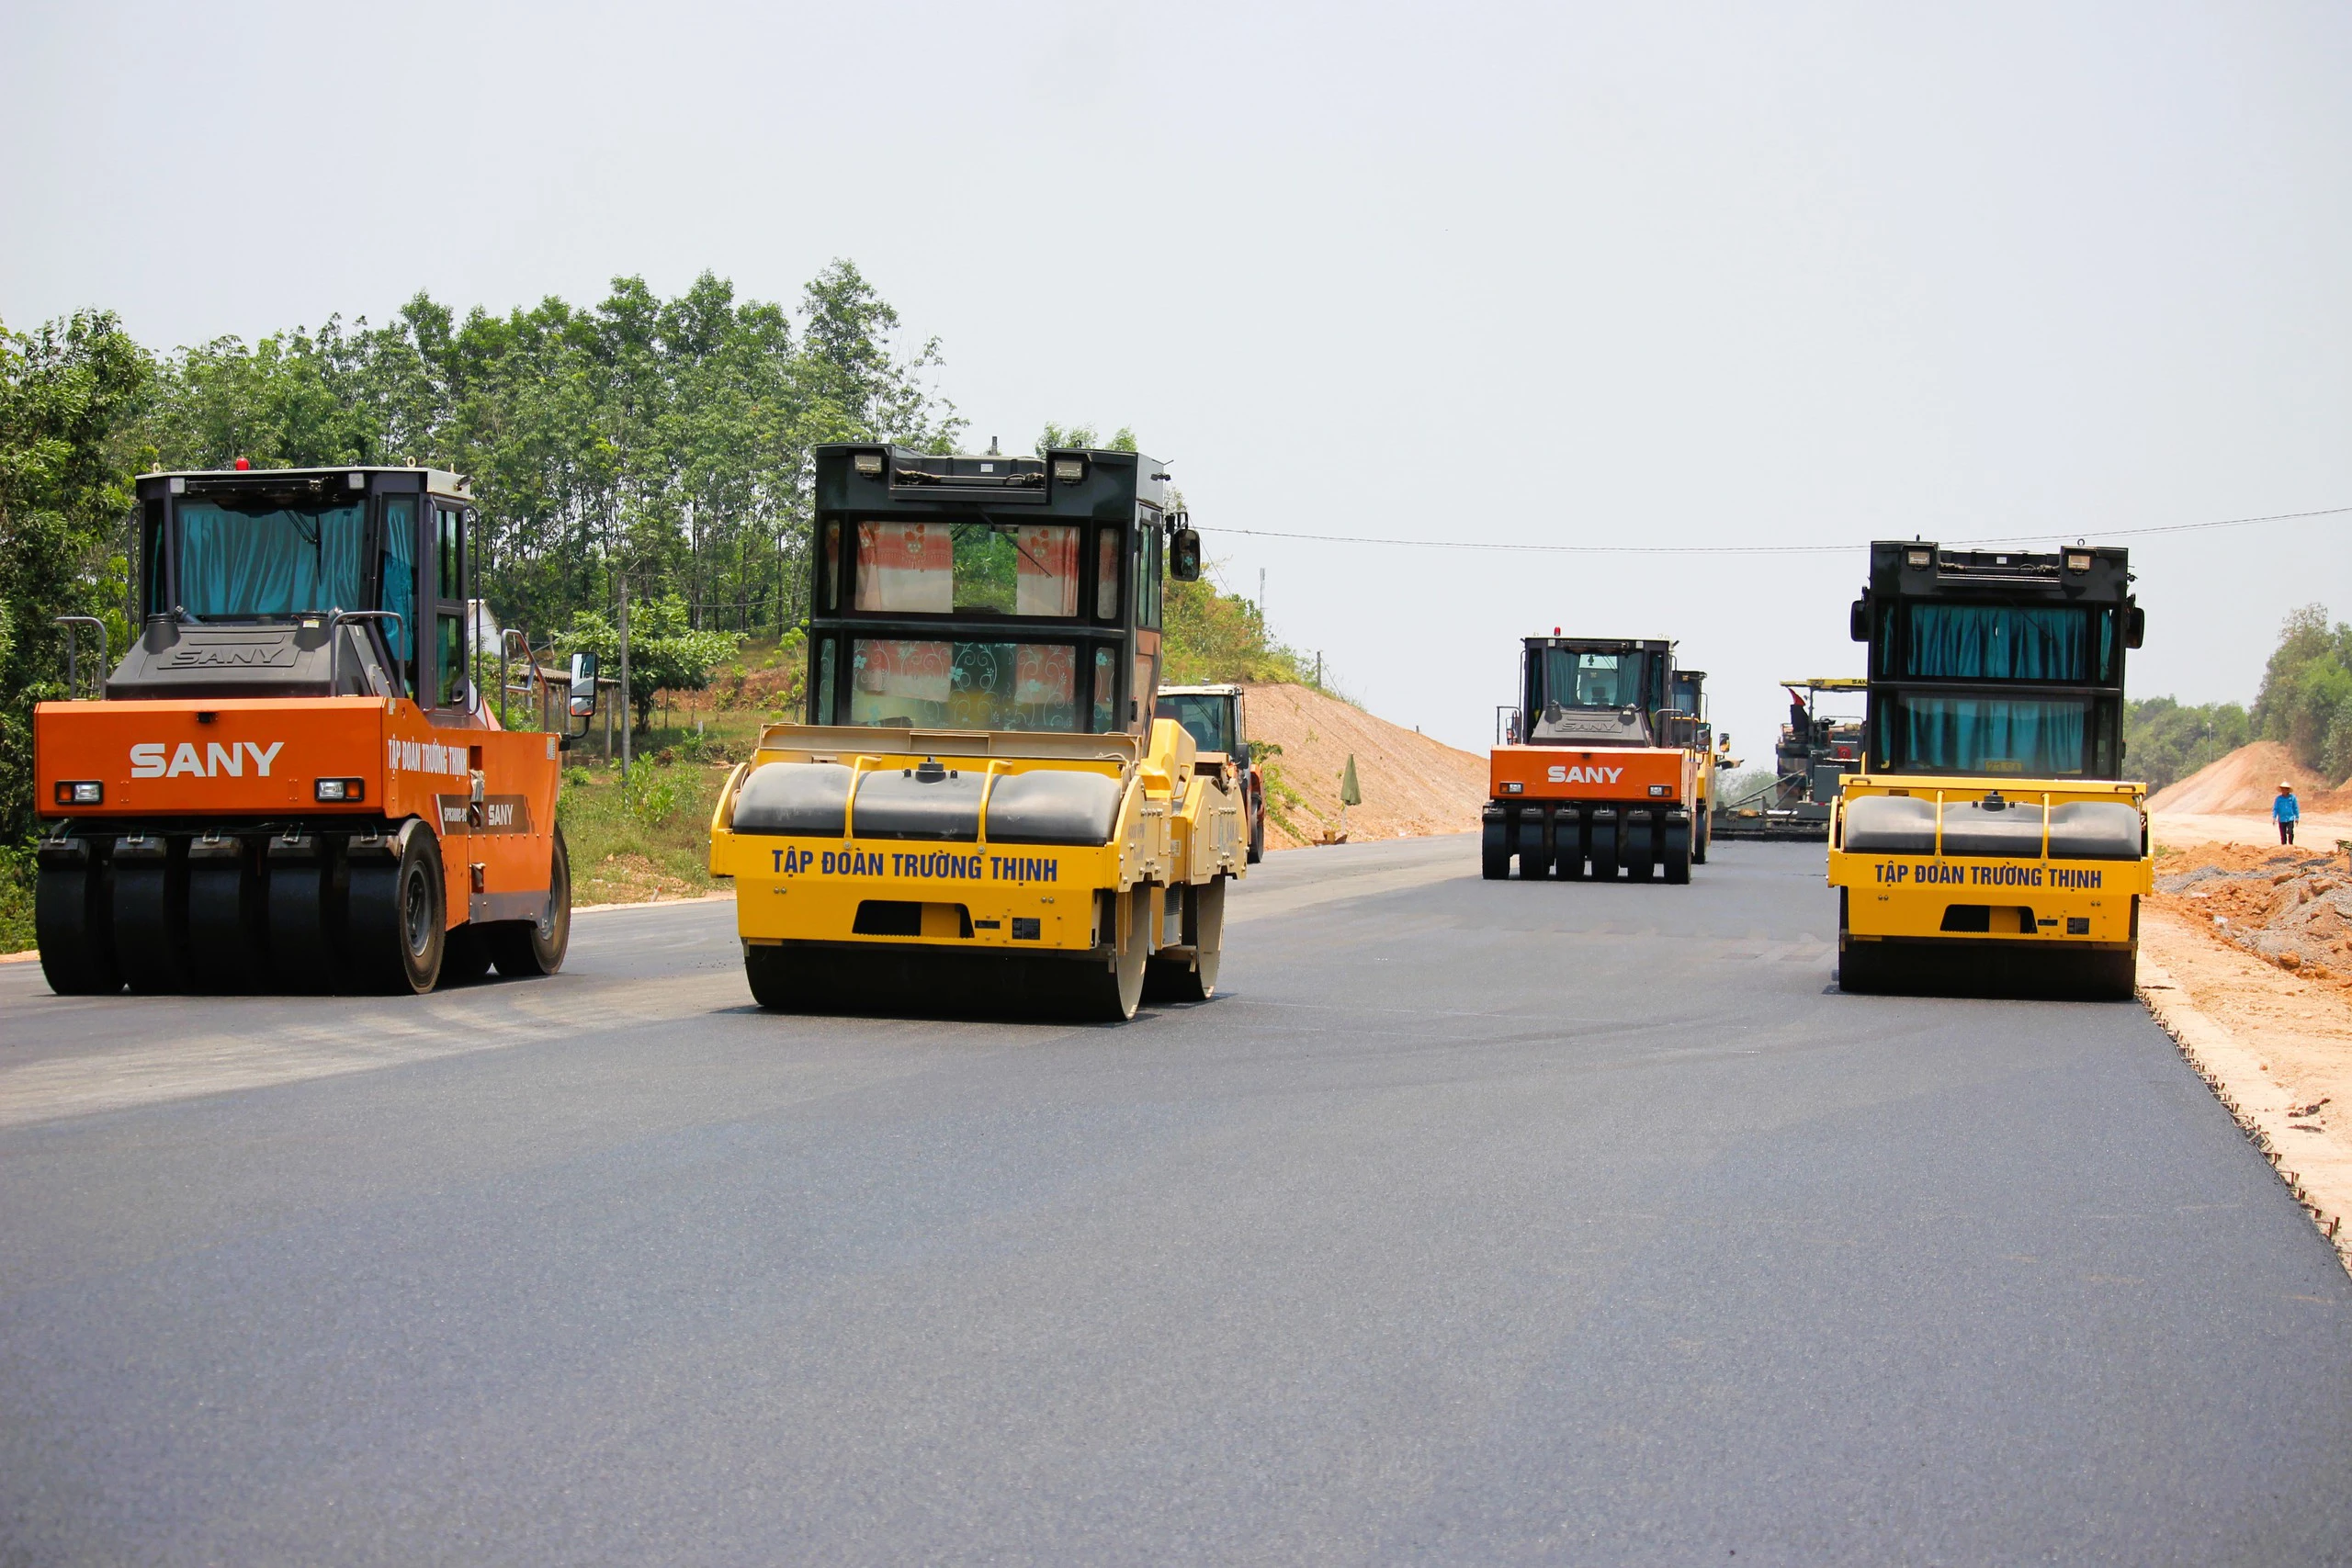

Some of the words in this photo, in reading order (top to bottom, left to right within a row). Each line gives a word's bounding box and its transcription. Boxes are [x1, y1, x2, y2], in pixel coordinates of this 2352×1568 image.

[171, 649, 285, 664] SANY
[1562, 723, 1616, 731] SANY
[130, 742, 285, 778] SANY
[388, 734, 401, 774] TẬP
[401, 736, 420, 773] ĐOÀN
[422, 738, 447, 774] TRƯỜNG
[448, 746, 468, 782] THỊNH
[1547, 766, 1623, 784] SANY
[488, 804, 514, 826] SANY
[772, 845, 814, 878] TẬP
[821, 847, 884, 876] ĐOÀN
[891, 850, 982, 879] TRƯỜNG
[990, 856, 1057, 886] THỊNH
[1874, 860, 1909, 887] TẬP
[1914, 861, 1965, 886] ĐOÀN
[1971, 862, 2042, 886] TRƯỜNG
[2048, 868, 2102, 892] THỊNH
